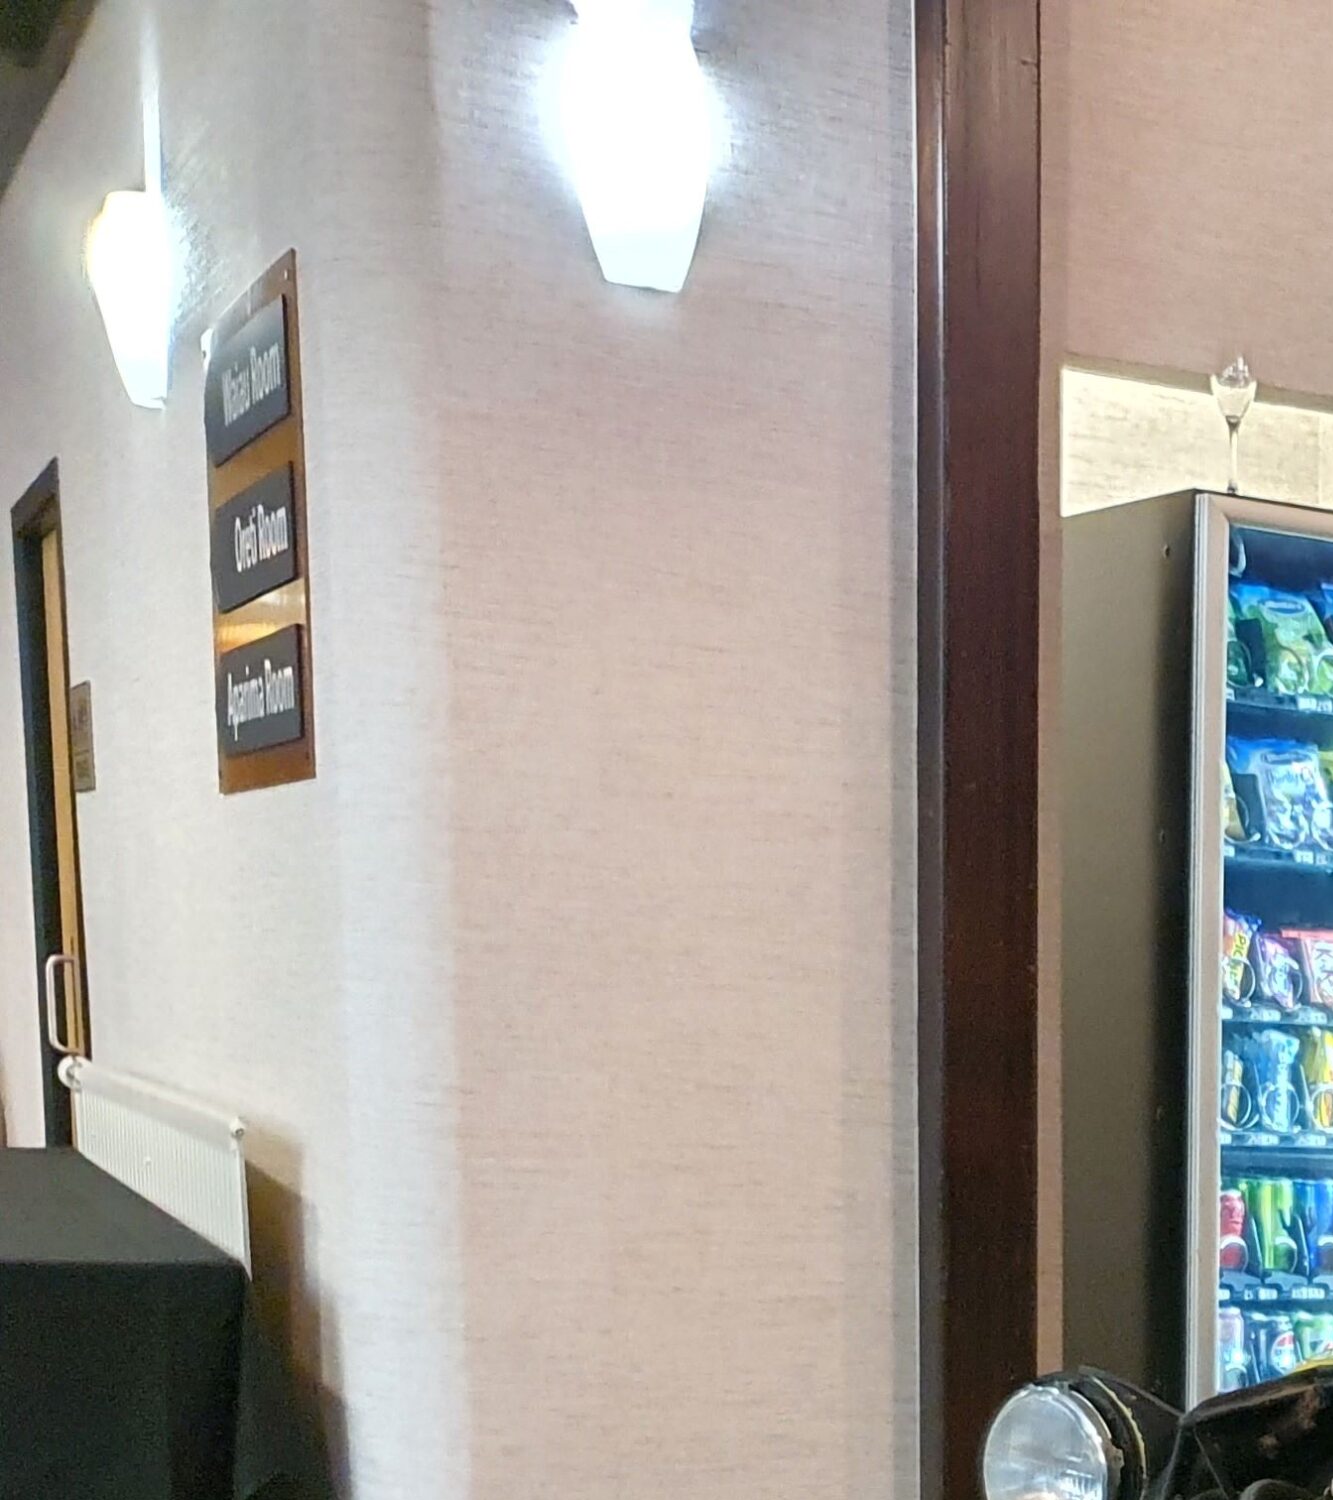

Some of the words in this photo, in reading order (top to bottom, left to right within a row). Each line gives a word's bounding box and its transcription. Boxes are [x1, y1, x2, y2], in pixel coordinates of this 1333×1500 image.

[250, 342, 281, 406] Room
[257, 503, 289, 561] Room
[264, 659, 296, 715] Room
